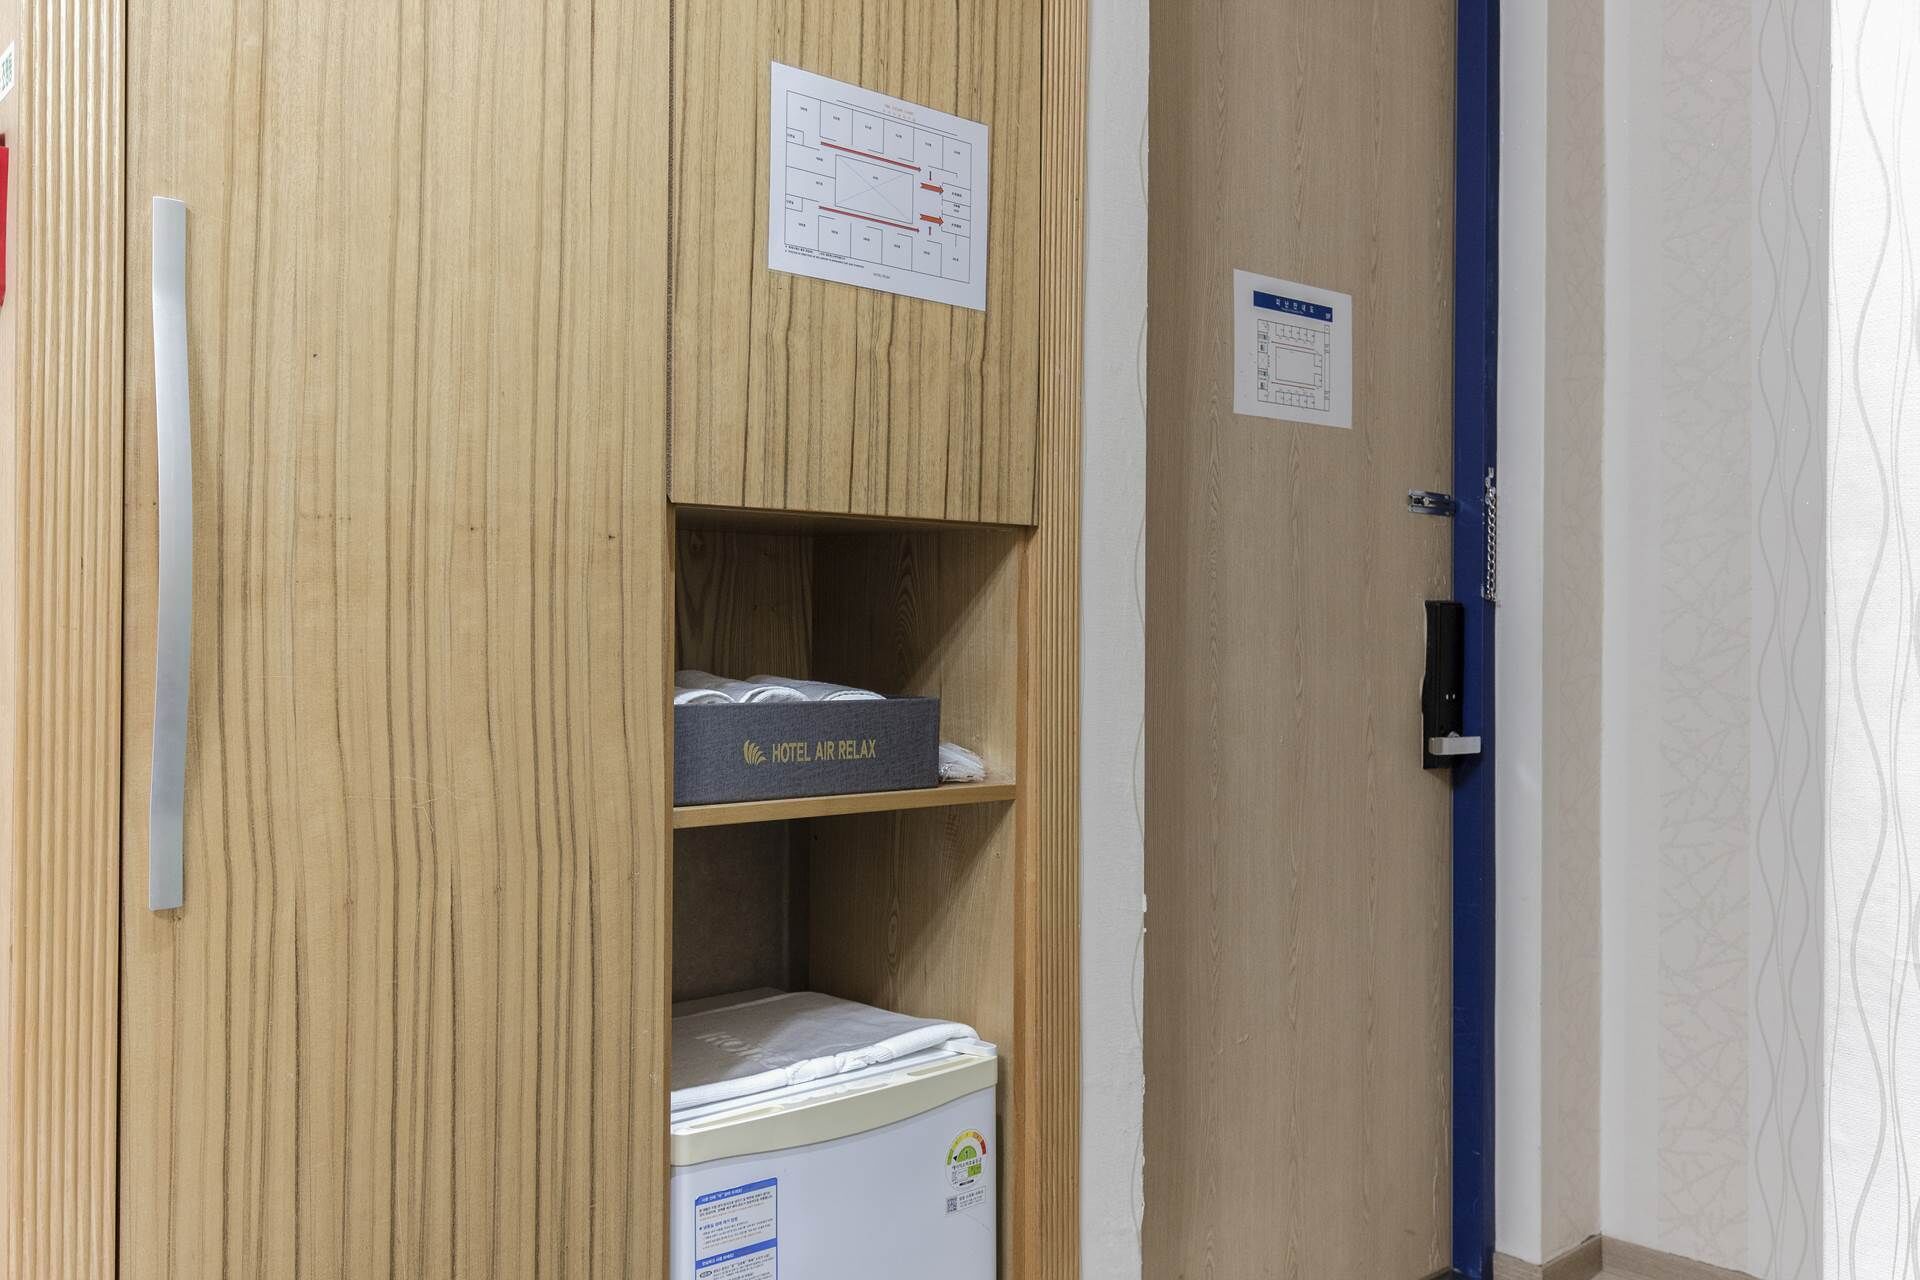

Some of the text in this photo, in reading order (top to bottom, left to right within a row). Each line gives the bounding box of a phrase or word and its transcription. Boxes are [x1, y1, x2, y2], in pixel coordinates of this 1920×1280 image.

[772, 740, 876, 762] HOTEL AIR RELAX
